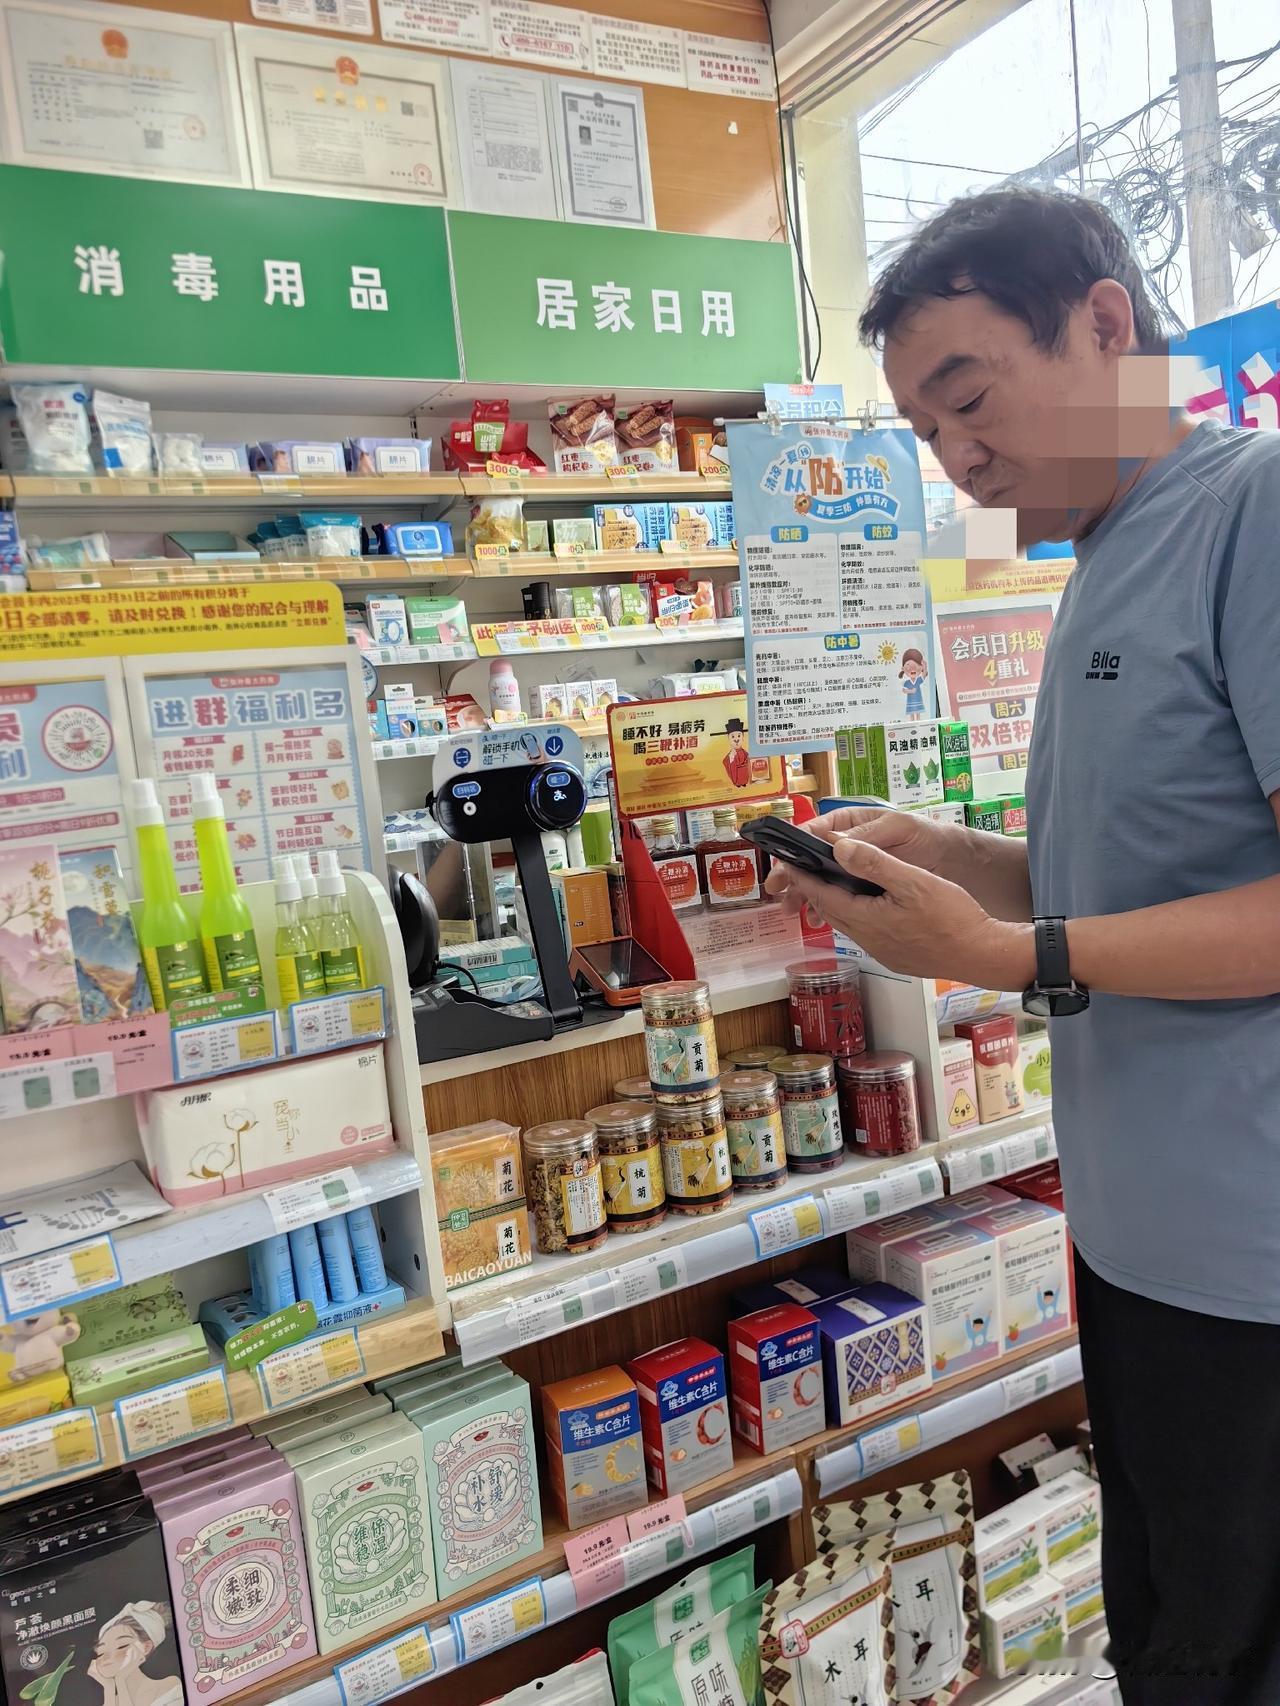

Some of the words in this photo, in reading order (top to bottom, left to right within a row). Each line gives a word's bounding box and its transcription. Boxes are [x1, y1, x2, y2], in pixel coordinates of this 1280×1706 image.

[74, 245, 389, 311] 消毒用品
[536, 277, 736, 338] 居家日用
[489, 463, 508, 475] 300
[608, 468, 626, 476] 300
[703, 466, 720, 474] 200
[825, 634, 859, 649] 防中暑
[951, 629, 1045, 661] 会员日升级
[983, 657, 1029, 681] 4重礼
[153, 690, 345, 728] 进群福利多
[994, 700, 1023, 718] 周六
[622, 724, 663, 741] 睡不好
[668, 719, 706, 736] 易疲劳
[943, 733, 969, 752] 风油精
[482, 741, 520, 755] 解锁手机
[633, 735, 699, 755] 喝三鞭补酒
[889, 738, 919, 753] 风油精
[482, 754, 509, 766] 碰一下
[661, 865, 689, 877] 三鞭补酒
[715, 859, 747, 871] 三鞭补酒
[357, 1055, 378, 1069] 棉片
[690, 1042, 705, 1073] 贡菊
[760, 1133, 774, 1164] 贡菊
[501, 1161, 515, 1194] 菊花
[633, 1166, 647, 1199] 杭菊
[503, 1225, 516, 1256] 菊花
[444, 1251, 533, 1289] BAICAOYUAN
[767, 1345, 815, 1371] 维生素C含片
[668, 1381, 718, 1411] 维生素C含片
[573, 1413, 632, 1441] 维生素C含片
[470, 1474, 487, 1514] 补水
[353, 1525, 371, 1563] 维稳
[371, 1517, 388, 1556] 保湿
[225, 1576, 244, 1617] 柔嫩
[242, 1568, 265, 1609] 细致
[14, 1612, 43, 1631] 芦荟
[824, 1637, 869, 1684] 木耳
